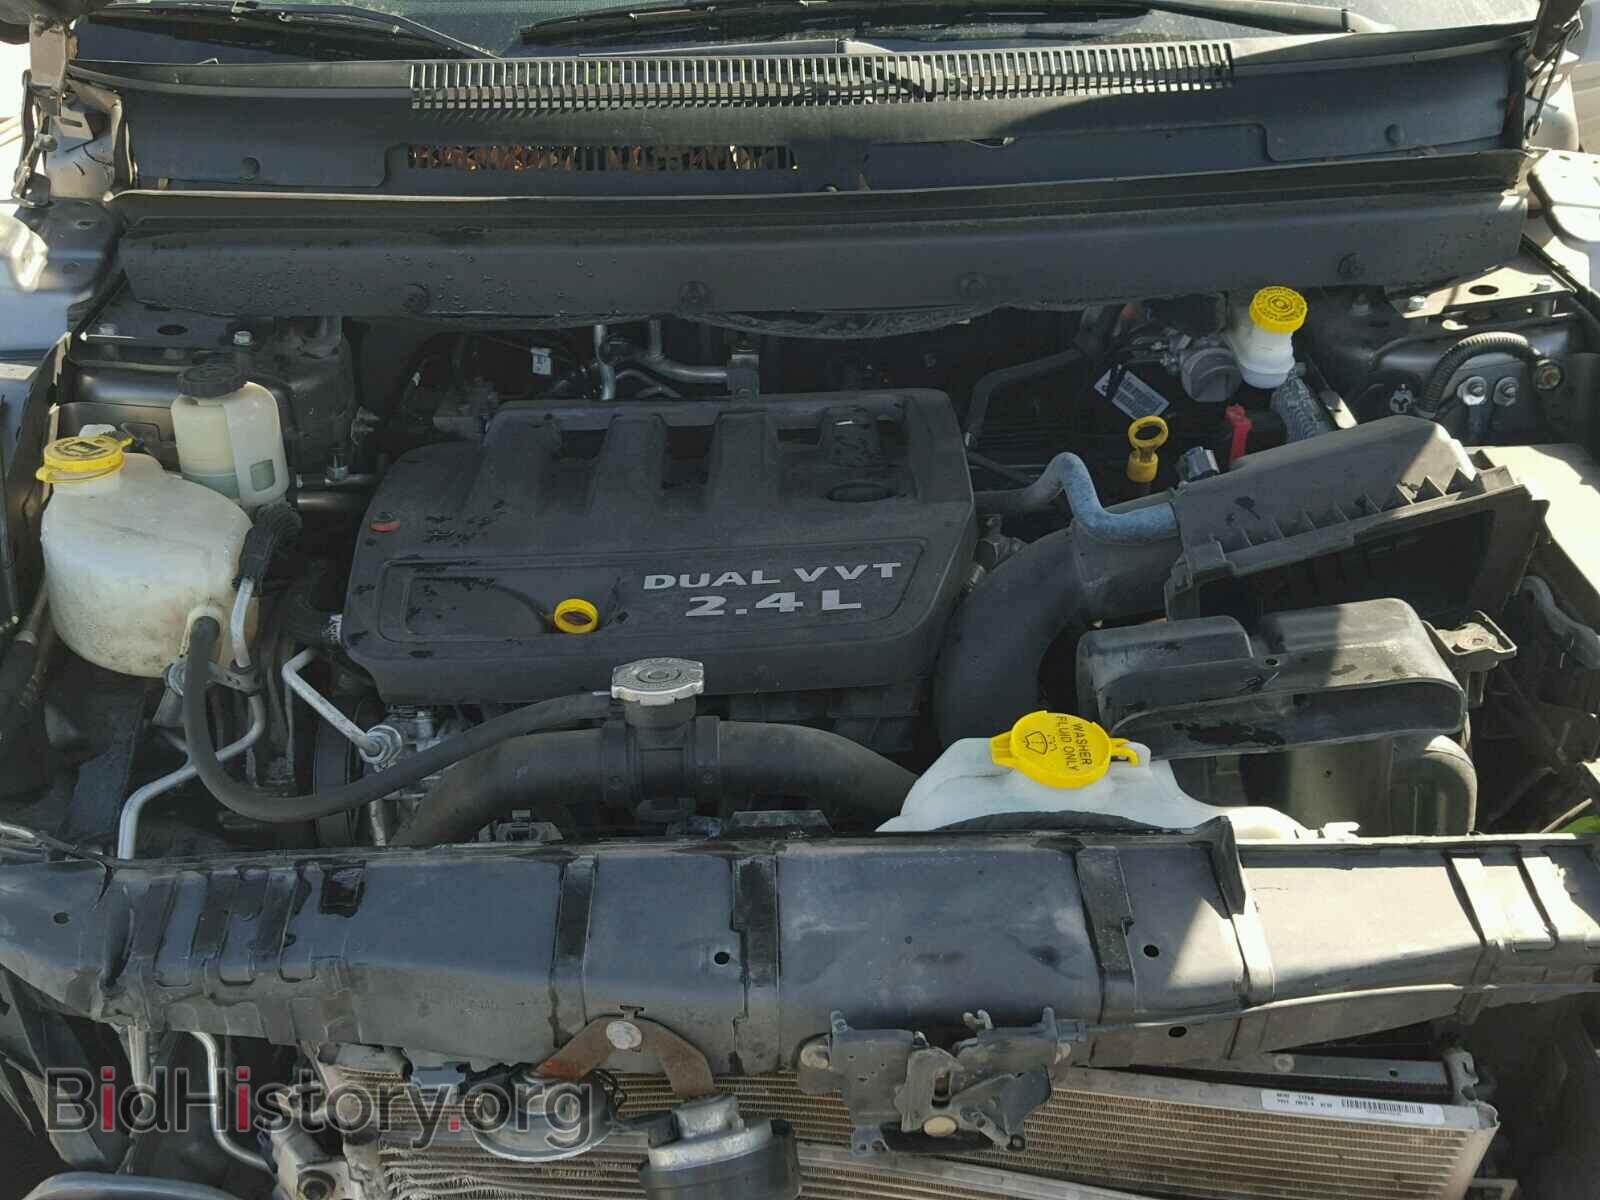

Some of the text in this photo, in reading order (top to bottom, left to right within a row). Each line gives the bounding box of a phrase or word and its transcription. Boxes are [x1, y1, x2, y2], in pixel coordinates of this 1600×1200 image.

[643, 562, 902, 590] DUAL VVT
[1057, 716, 1080, 772] FLUID ONLY
[1072, 722, 1093, 766] WASHER
